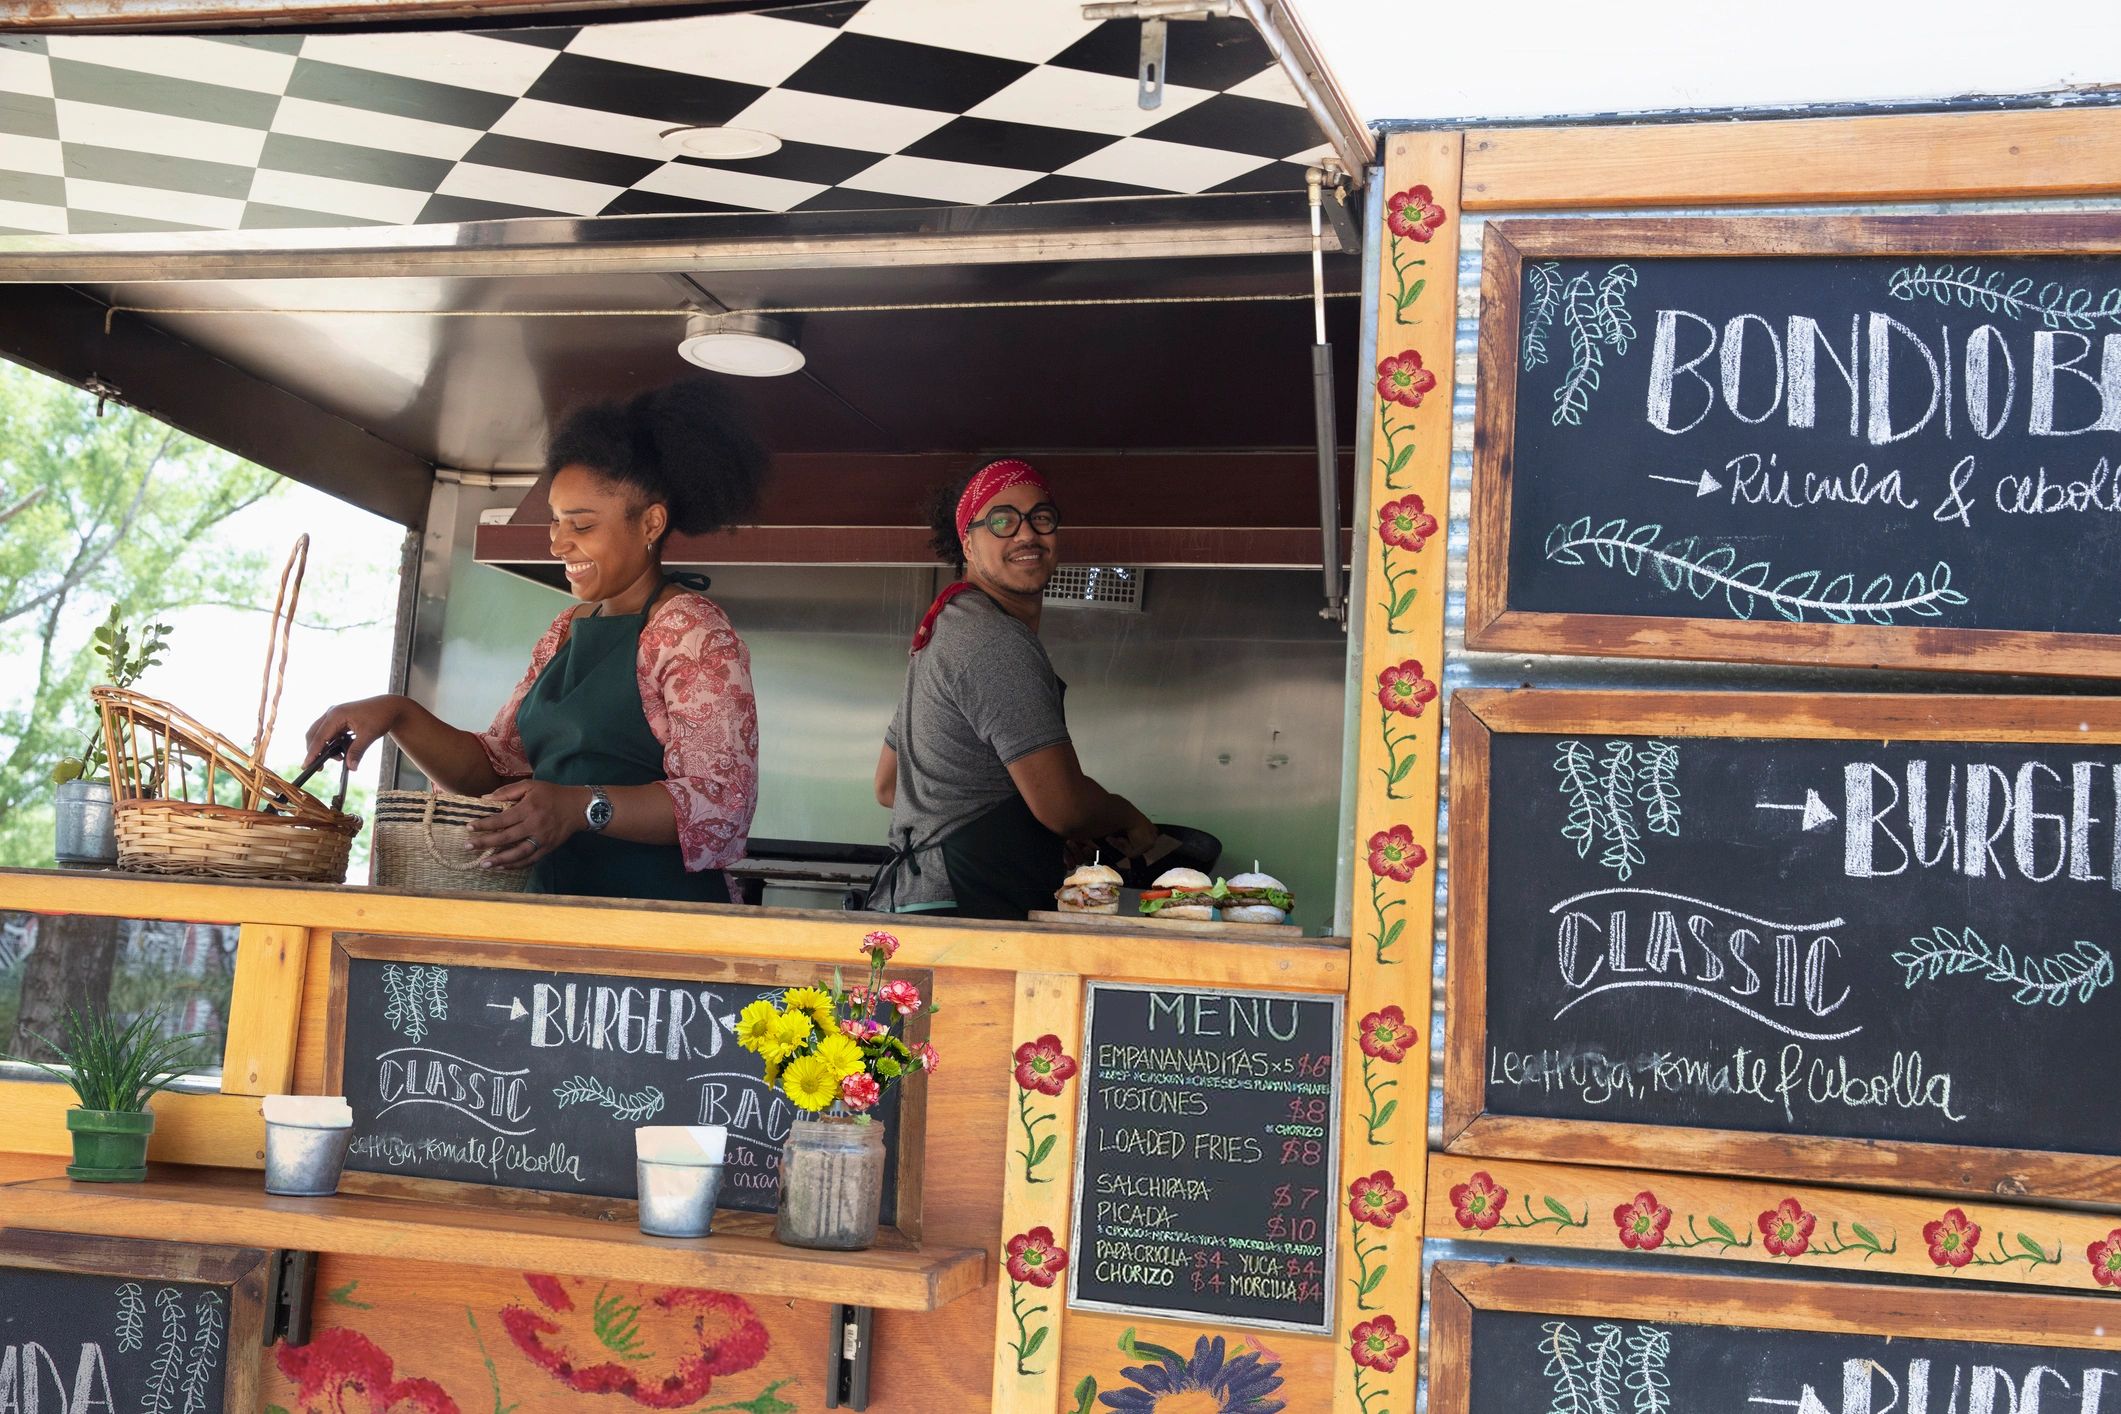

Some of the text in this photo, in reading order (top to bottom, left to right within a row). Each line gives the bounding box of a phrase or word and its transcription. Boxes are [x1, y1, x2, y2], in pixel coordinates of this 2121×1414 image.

[1647, 309, 2121, 445] BONDIOB
[1933, 455, 1975, 527] &
[1844, 759, 2121, 890] BURGE
[1558, 911, 1850, 1016] CLASSIC
[531, 983, 723, 1060] BURGERS
[1149, 993, 1298, 1041] MENU
[379, 1059, 531, 1123] CLASSIC
[698, 1083, 820, 1141] BAC
[1099, 1086, 1325, 1123] TOSTONES $8
[1100, 1128, 1321, 1165] LOADED FRIES $8
[1275, 1124, 1324, 1137] CHORIZO
[1097, 1174, 1213, 1201] SALCHIPAPA
[1098, 1201, 1316, 1241] PICADA $10
[1096, 1261, 1174, 1286] CHORIZO
[1230, 1275, 1297, 1301] MORCILLA
[1238, 1253, 1283, 1276] YUCA
